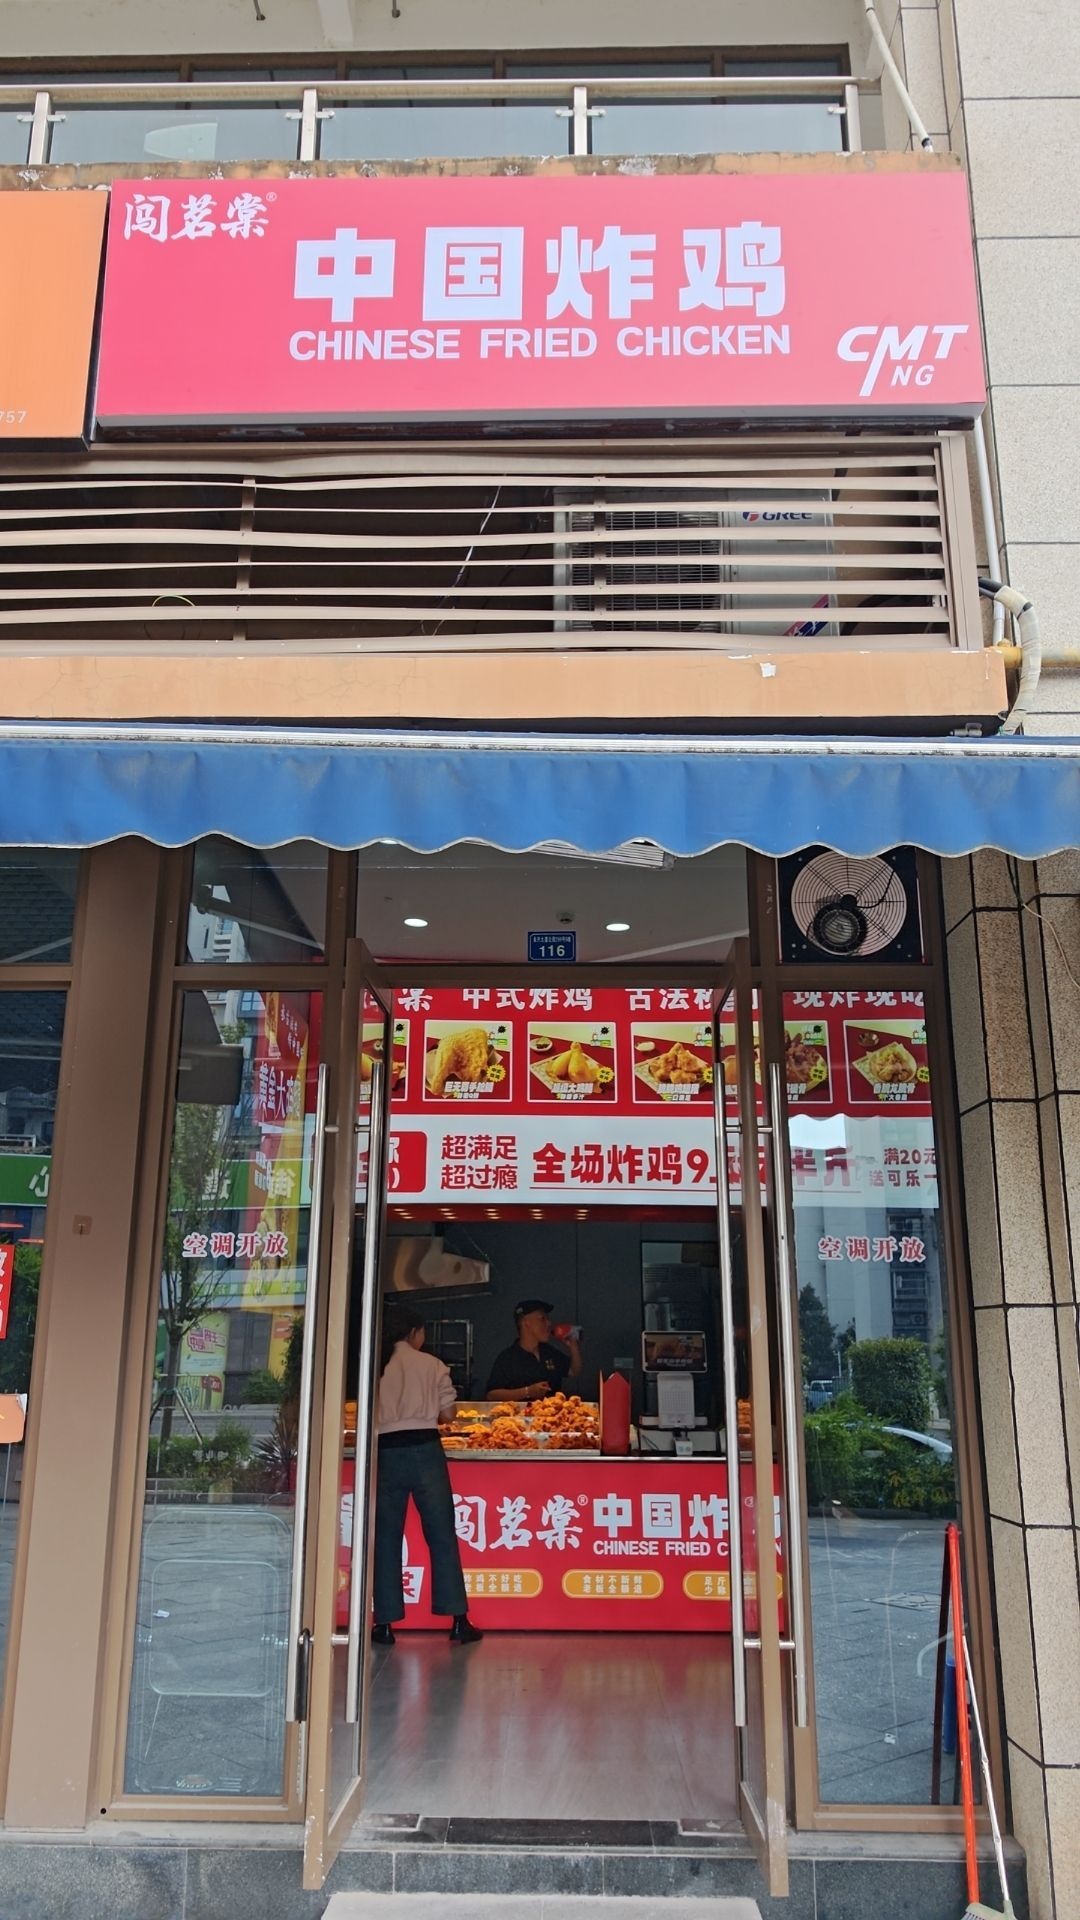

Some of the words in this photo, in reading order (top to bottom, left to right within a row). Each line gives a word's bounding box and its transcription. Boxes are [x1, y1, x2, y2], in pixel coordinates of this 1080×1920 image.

[294, 221, 786, 322] 中国炸鸡
[289, 329, 461, 361] CHINESE
[479, 327, 597, 359] FRIED
[616, 324, 791, 357] CHICKEN
[539, 945, 565, 958] 116
[462, 988, 593, 1011] 中式炸鸡
[440, 1134, 518, 1161] 超满足
[440, 1164, 518, 1190] 超过瘾
[182, 1231, 289, 1259] 空调开放
[818, 1236, 926, 1263] 空调开放
[593, 1492, 781, 1540] 中国炸
[593, 1541, 659, 1556] CHINESE
[665, 1541, 711, 1556] FRIED
